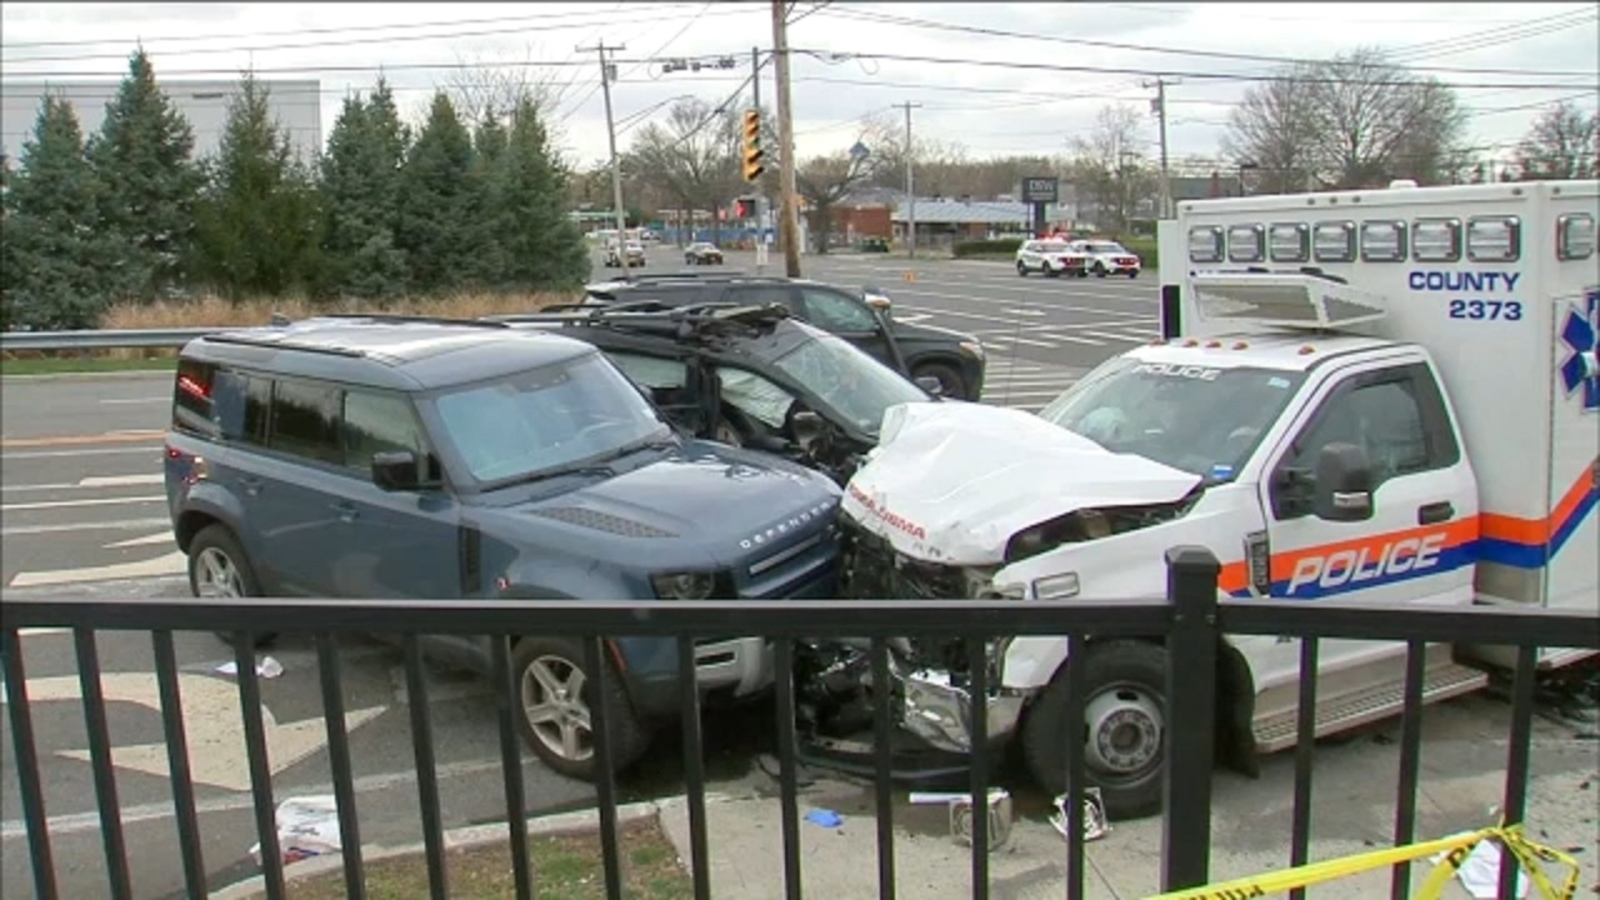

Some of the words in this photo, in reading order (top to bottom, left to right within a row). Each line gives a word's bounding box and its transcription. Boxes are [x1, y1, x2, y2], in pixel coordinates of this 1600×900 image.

[1409, 271, 1520, 292] COUNTY
[1449, 299, 1522, 321] 2373
[1131, 363, 1221, 381] POLICE
[740, 501, 831, 549] DEFENDER
[1286, 532, 1446, 595] POLICE
